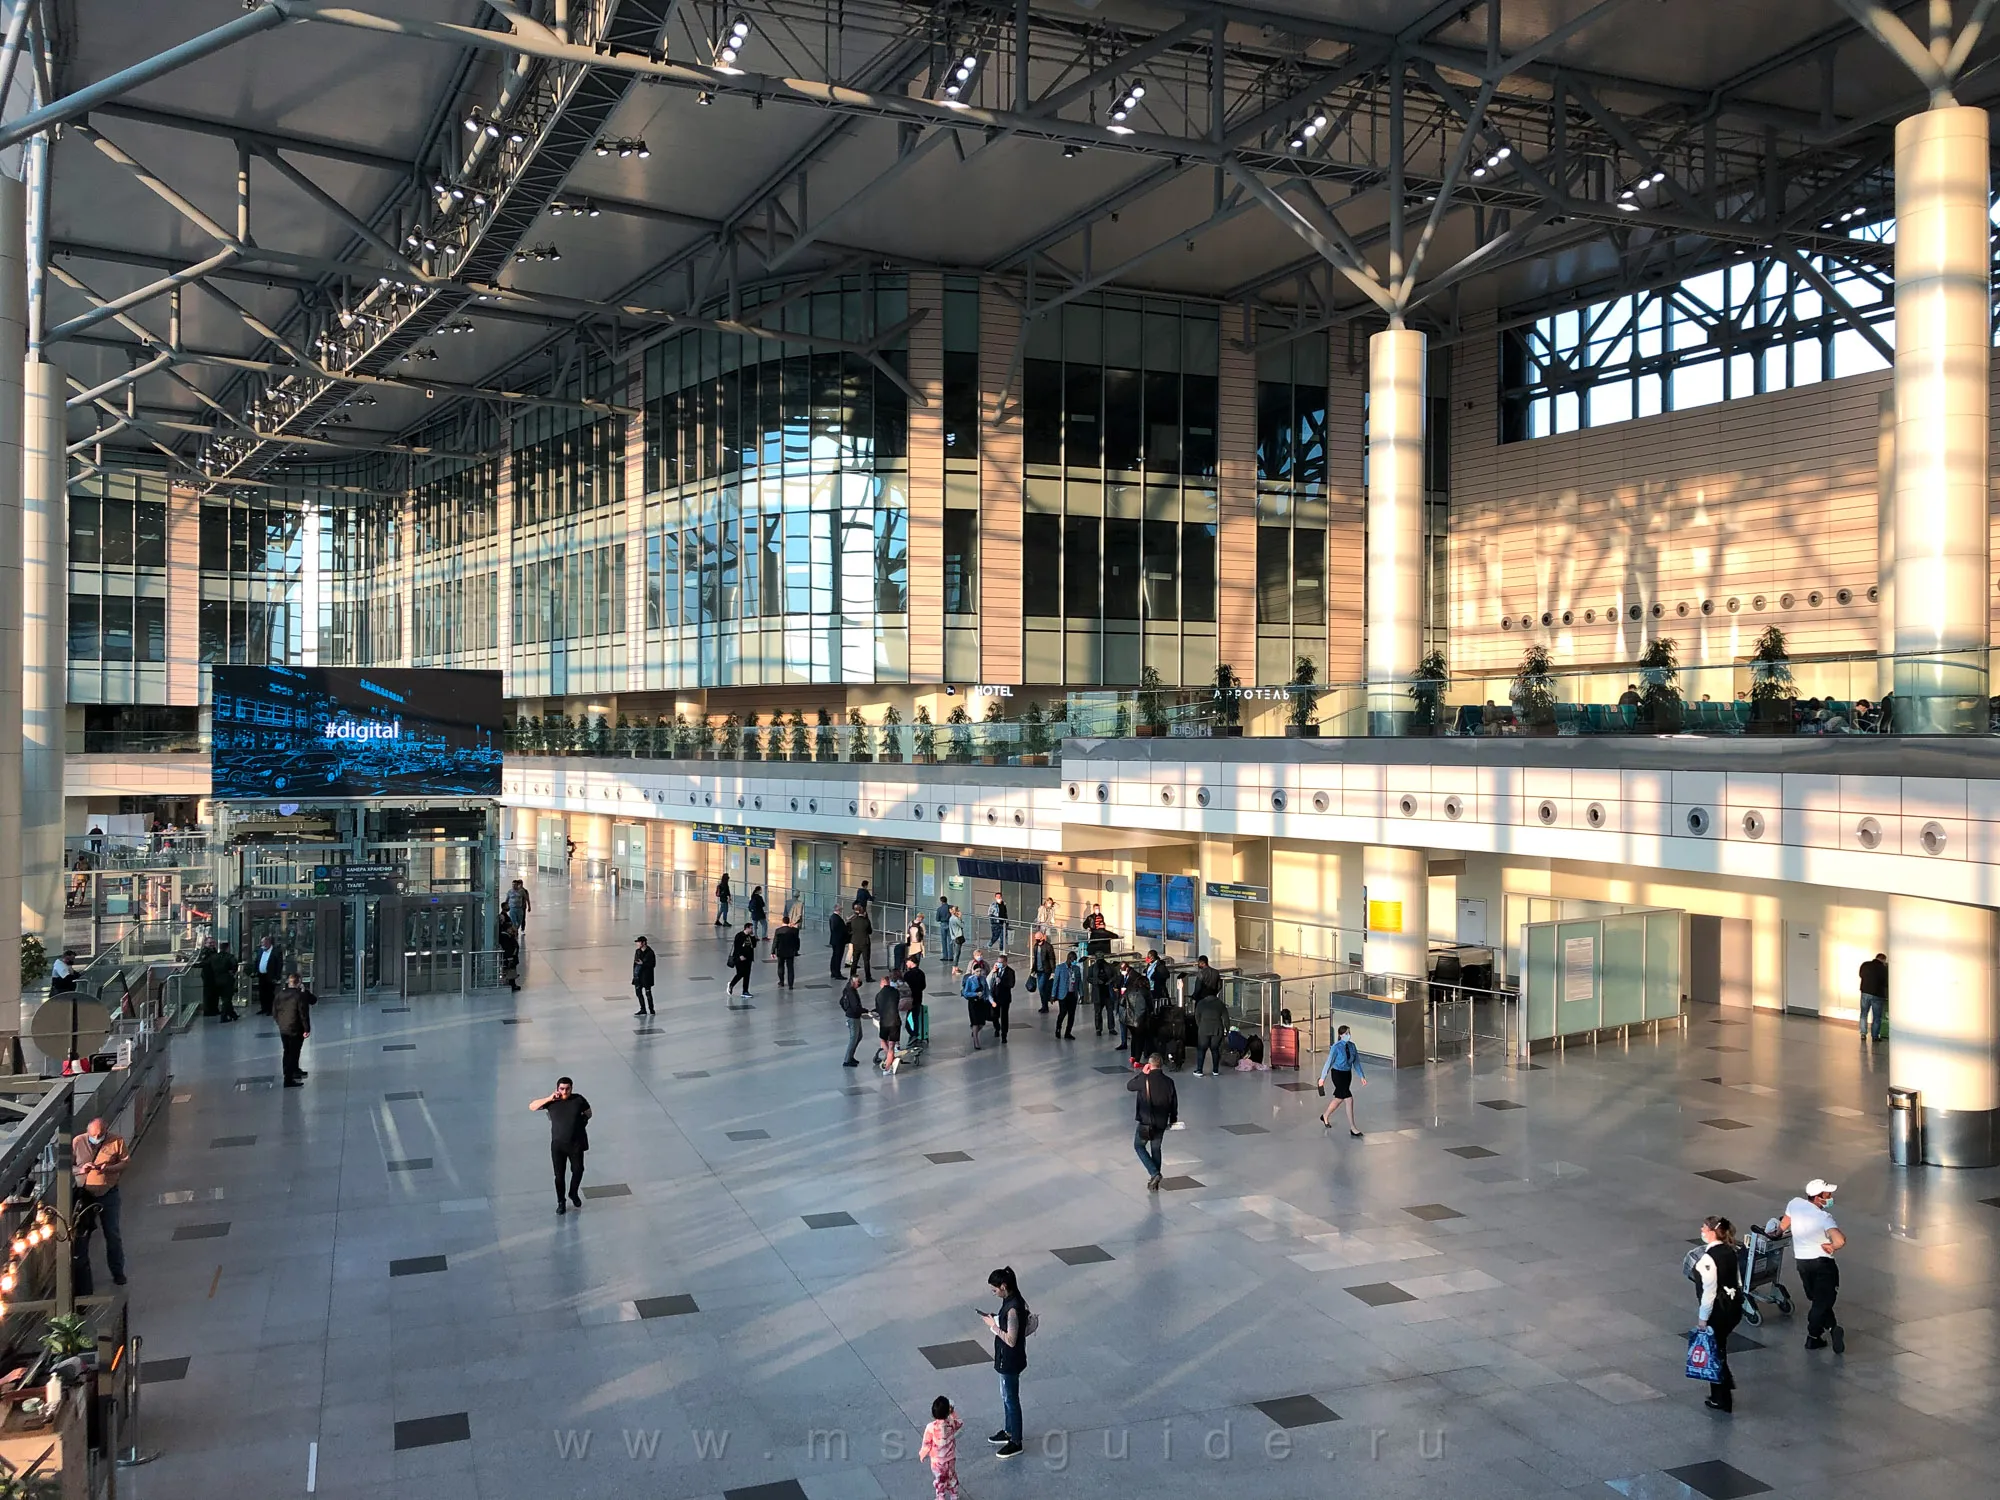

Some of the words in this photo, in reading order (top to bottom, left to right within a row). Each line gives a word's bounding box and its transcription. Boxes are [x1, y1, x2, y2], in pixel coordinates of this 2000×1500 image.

[975, 685, 1013, 697] HOTEL
[325, 721, 399, 742] #digital
[1692, 1350, 1706, 1363] GJ
